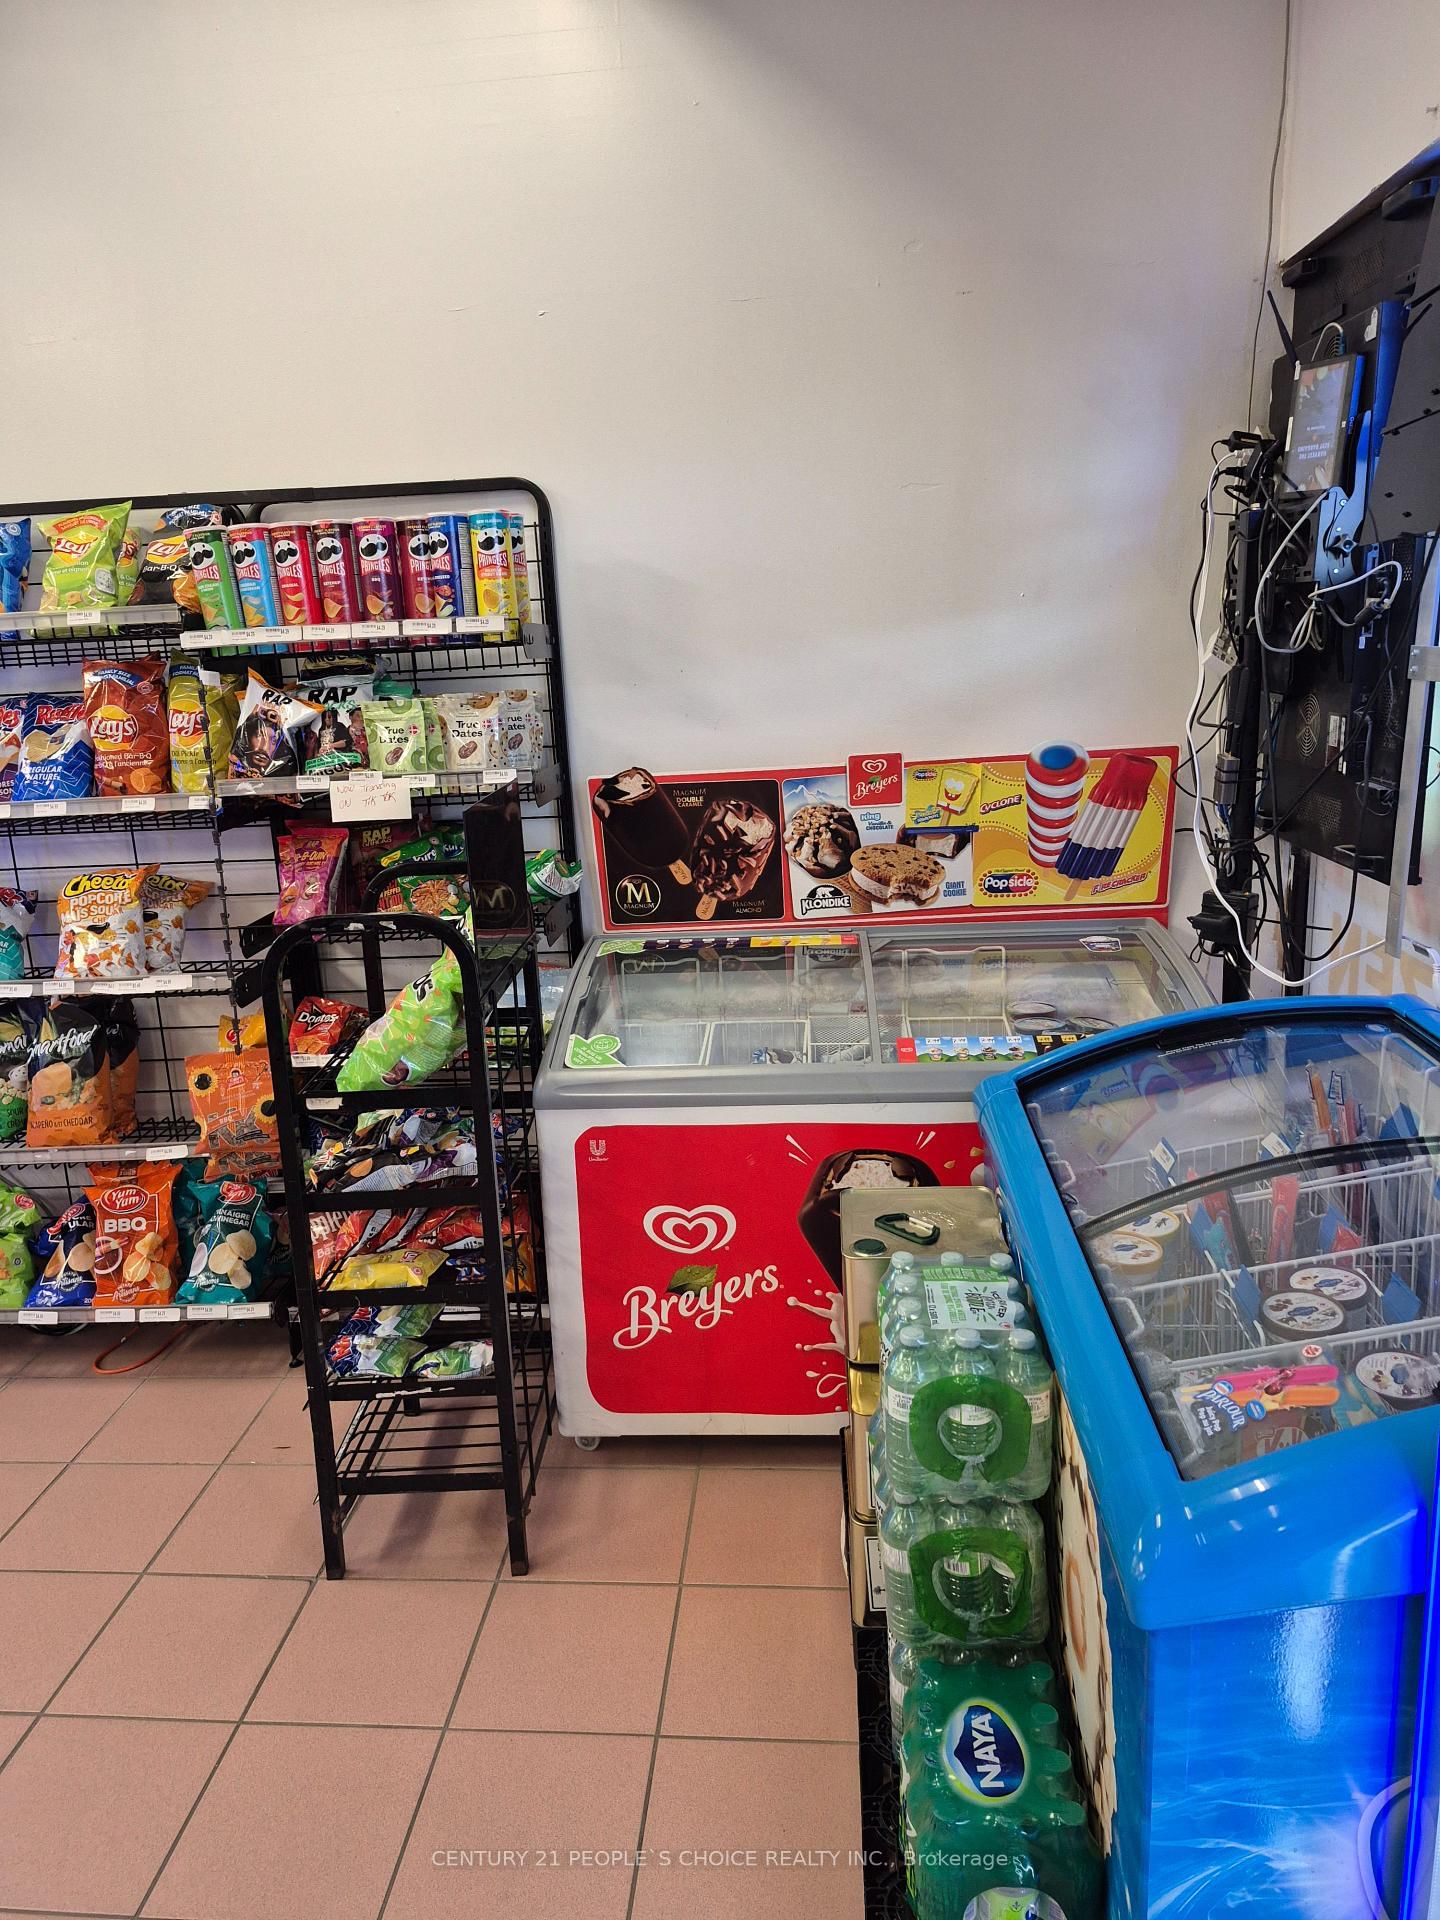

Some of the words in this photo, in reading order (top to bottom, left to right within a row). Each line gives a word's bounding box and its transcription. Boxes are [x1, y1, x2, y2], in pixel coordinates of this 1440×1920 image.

[360, 557, 391, 575] PRINGLES
[410, 558, 432, 574] PRING
[478, 552, 508, 567] PRINGLES
[308, 687, 358, 704] RAP
[384, 726, 405, 735] True
[455, 720, 479, 729] True
[507, 723, 526, 731] ates
[452, 729, 483, 738] Dates
[672, 788, 707, 797] MAGNUM
[853, 773, 898, 800] Breyers
[64, 873, 133, 898] Cheeto
[945, 881, 965, 890] GIANT
[984, 875, 1034, 891] Popsicle
[1090, 873, 1149, 896] FIRECRACKER
[943, 888, 967, 897] COOKIE
[801, 895, 851, 915] KLONDIKE
[63, 1117, 94, 1127] CHEDDAR
[111, 1188, 137, 1200] Yum
[115, 1196, 140, 1209] Yum
[104, 1216, 147, 1233] BBQ
[612, 1264, 780, 1350] Breyers
[1195, 1390, 1246, 1429] PARLOUR
[971, 1712, 1005, 1788] NAYA
